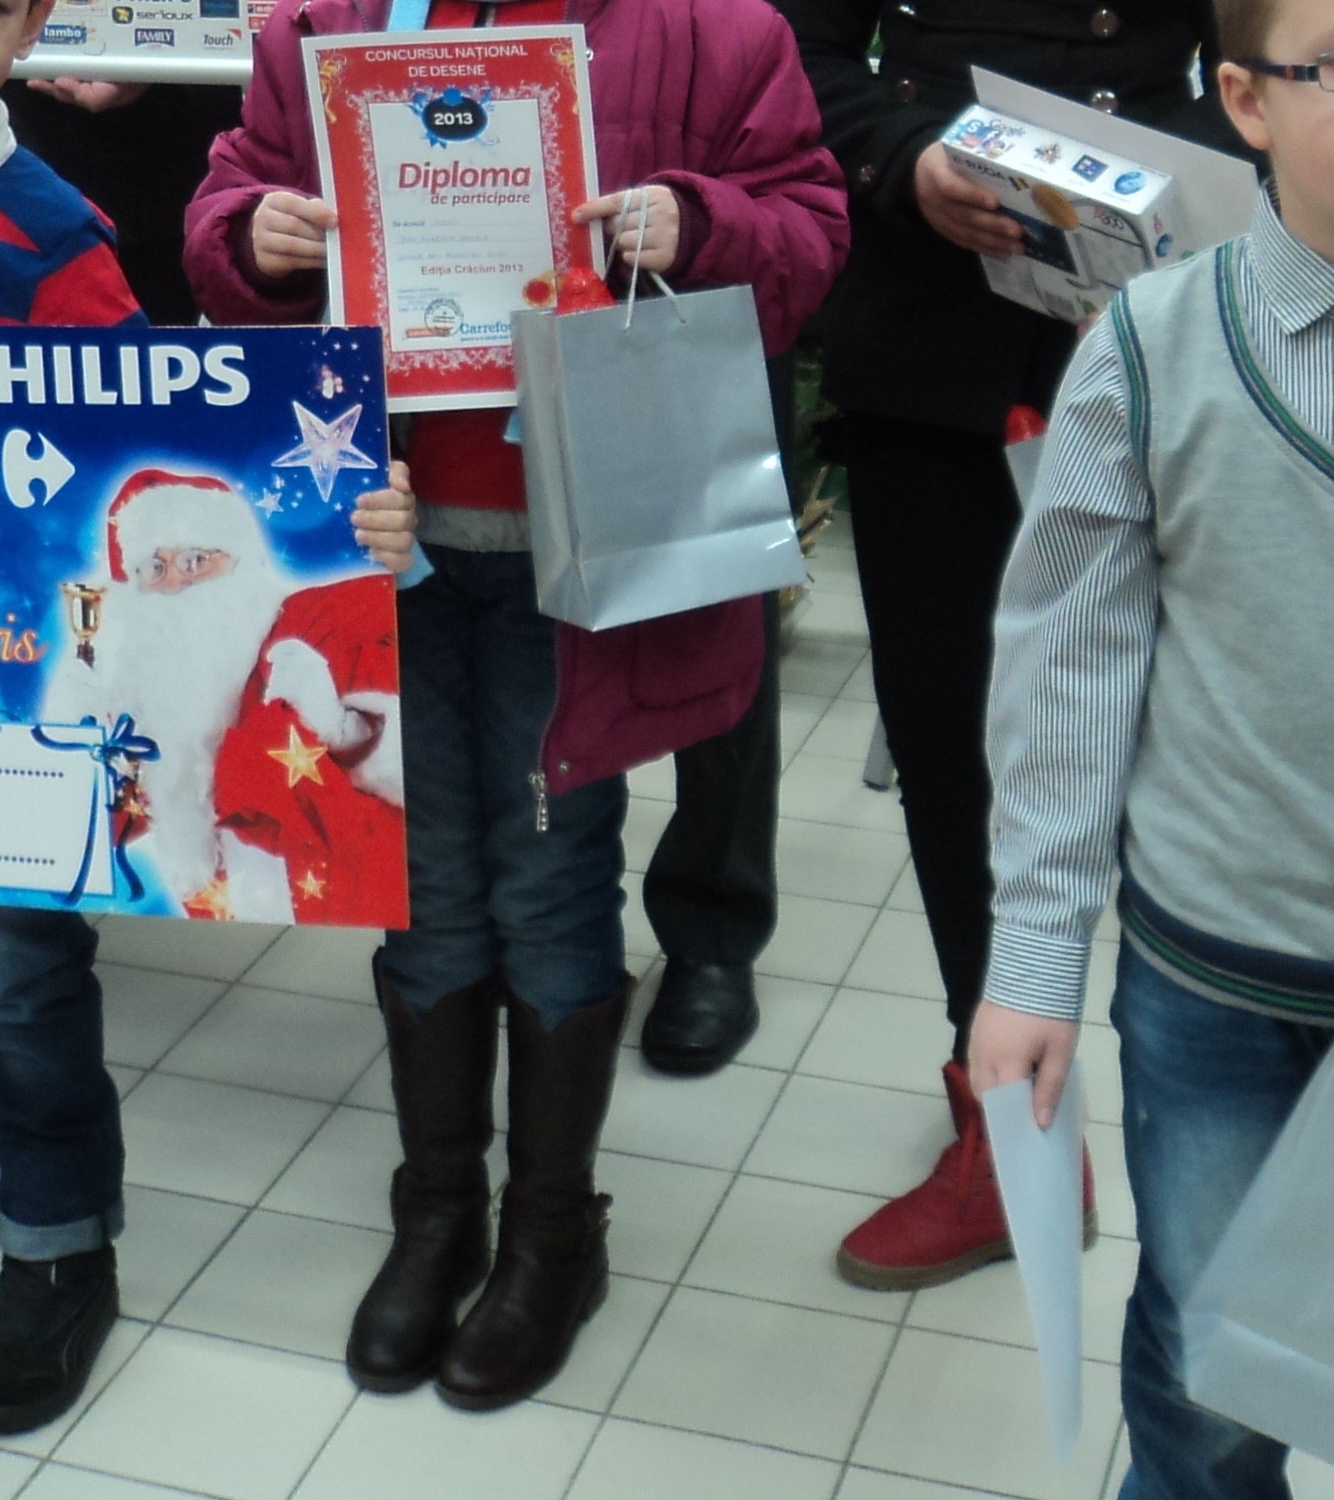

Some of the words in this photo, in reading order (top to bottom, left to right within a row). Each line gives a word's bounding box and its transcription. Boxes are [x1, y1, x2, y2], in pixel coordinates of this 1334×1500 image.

[136, 30, 173, 42] FAMILY
[203, 33, 234, 46] Touch
[365, 47, 457, 62] CONCURSUL
[460, 44, 528, 61] NAȚIONAL
[408, 66, 429, 77] DE
[431, 64, 486, 77] DESENE
[434, 112, 473, 126] 2013
[398, 160, 531, 195] Diploma
[430, 193, 448, 205] de
[452, 191, 531, 207] participare
[498, 264, 524, 273] 2013
[459, 320, 512, 335] Carrefo
